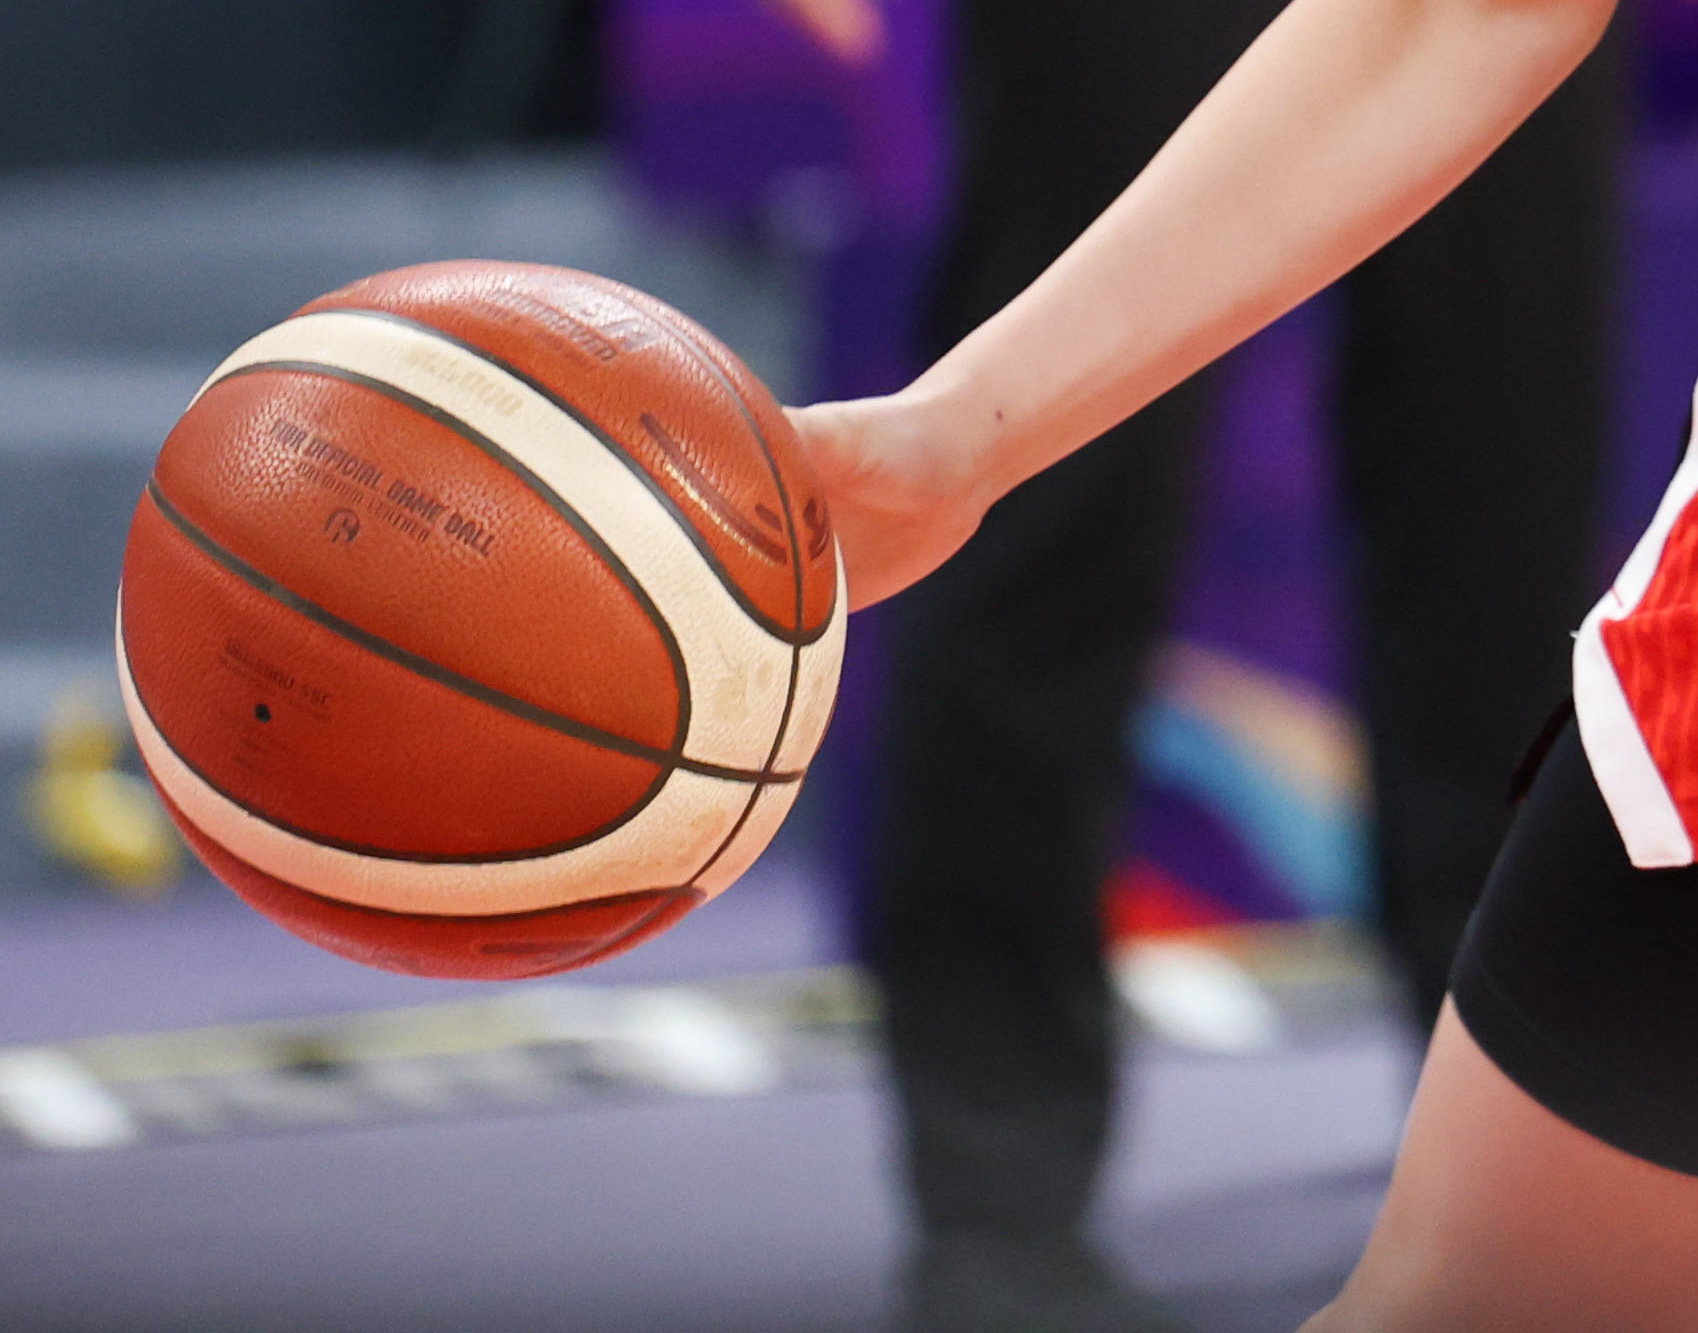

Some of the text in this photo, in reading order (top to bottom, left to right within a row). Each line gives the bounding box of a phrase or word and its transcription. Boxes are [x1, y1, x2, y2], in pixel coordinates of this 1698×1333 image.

[308, 437, 384, 491] OFFICIAL
[387, 480, 450, 524] GAME
[444, 512, 496, 558] BALL
